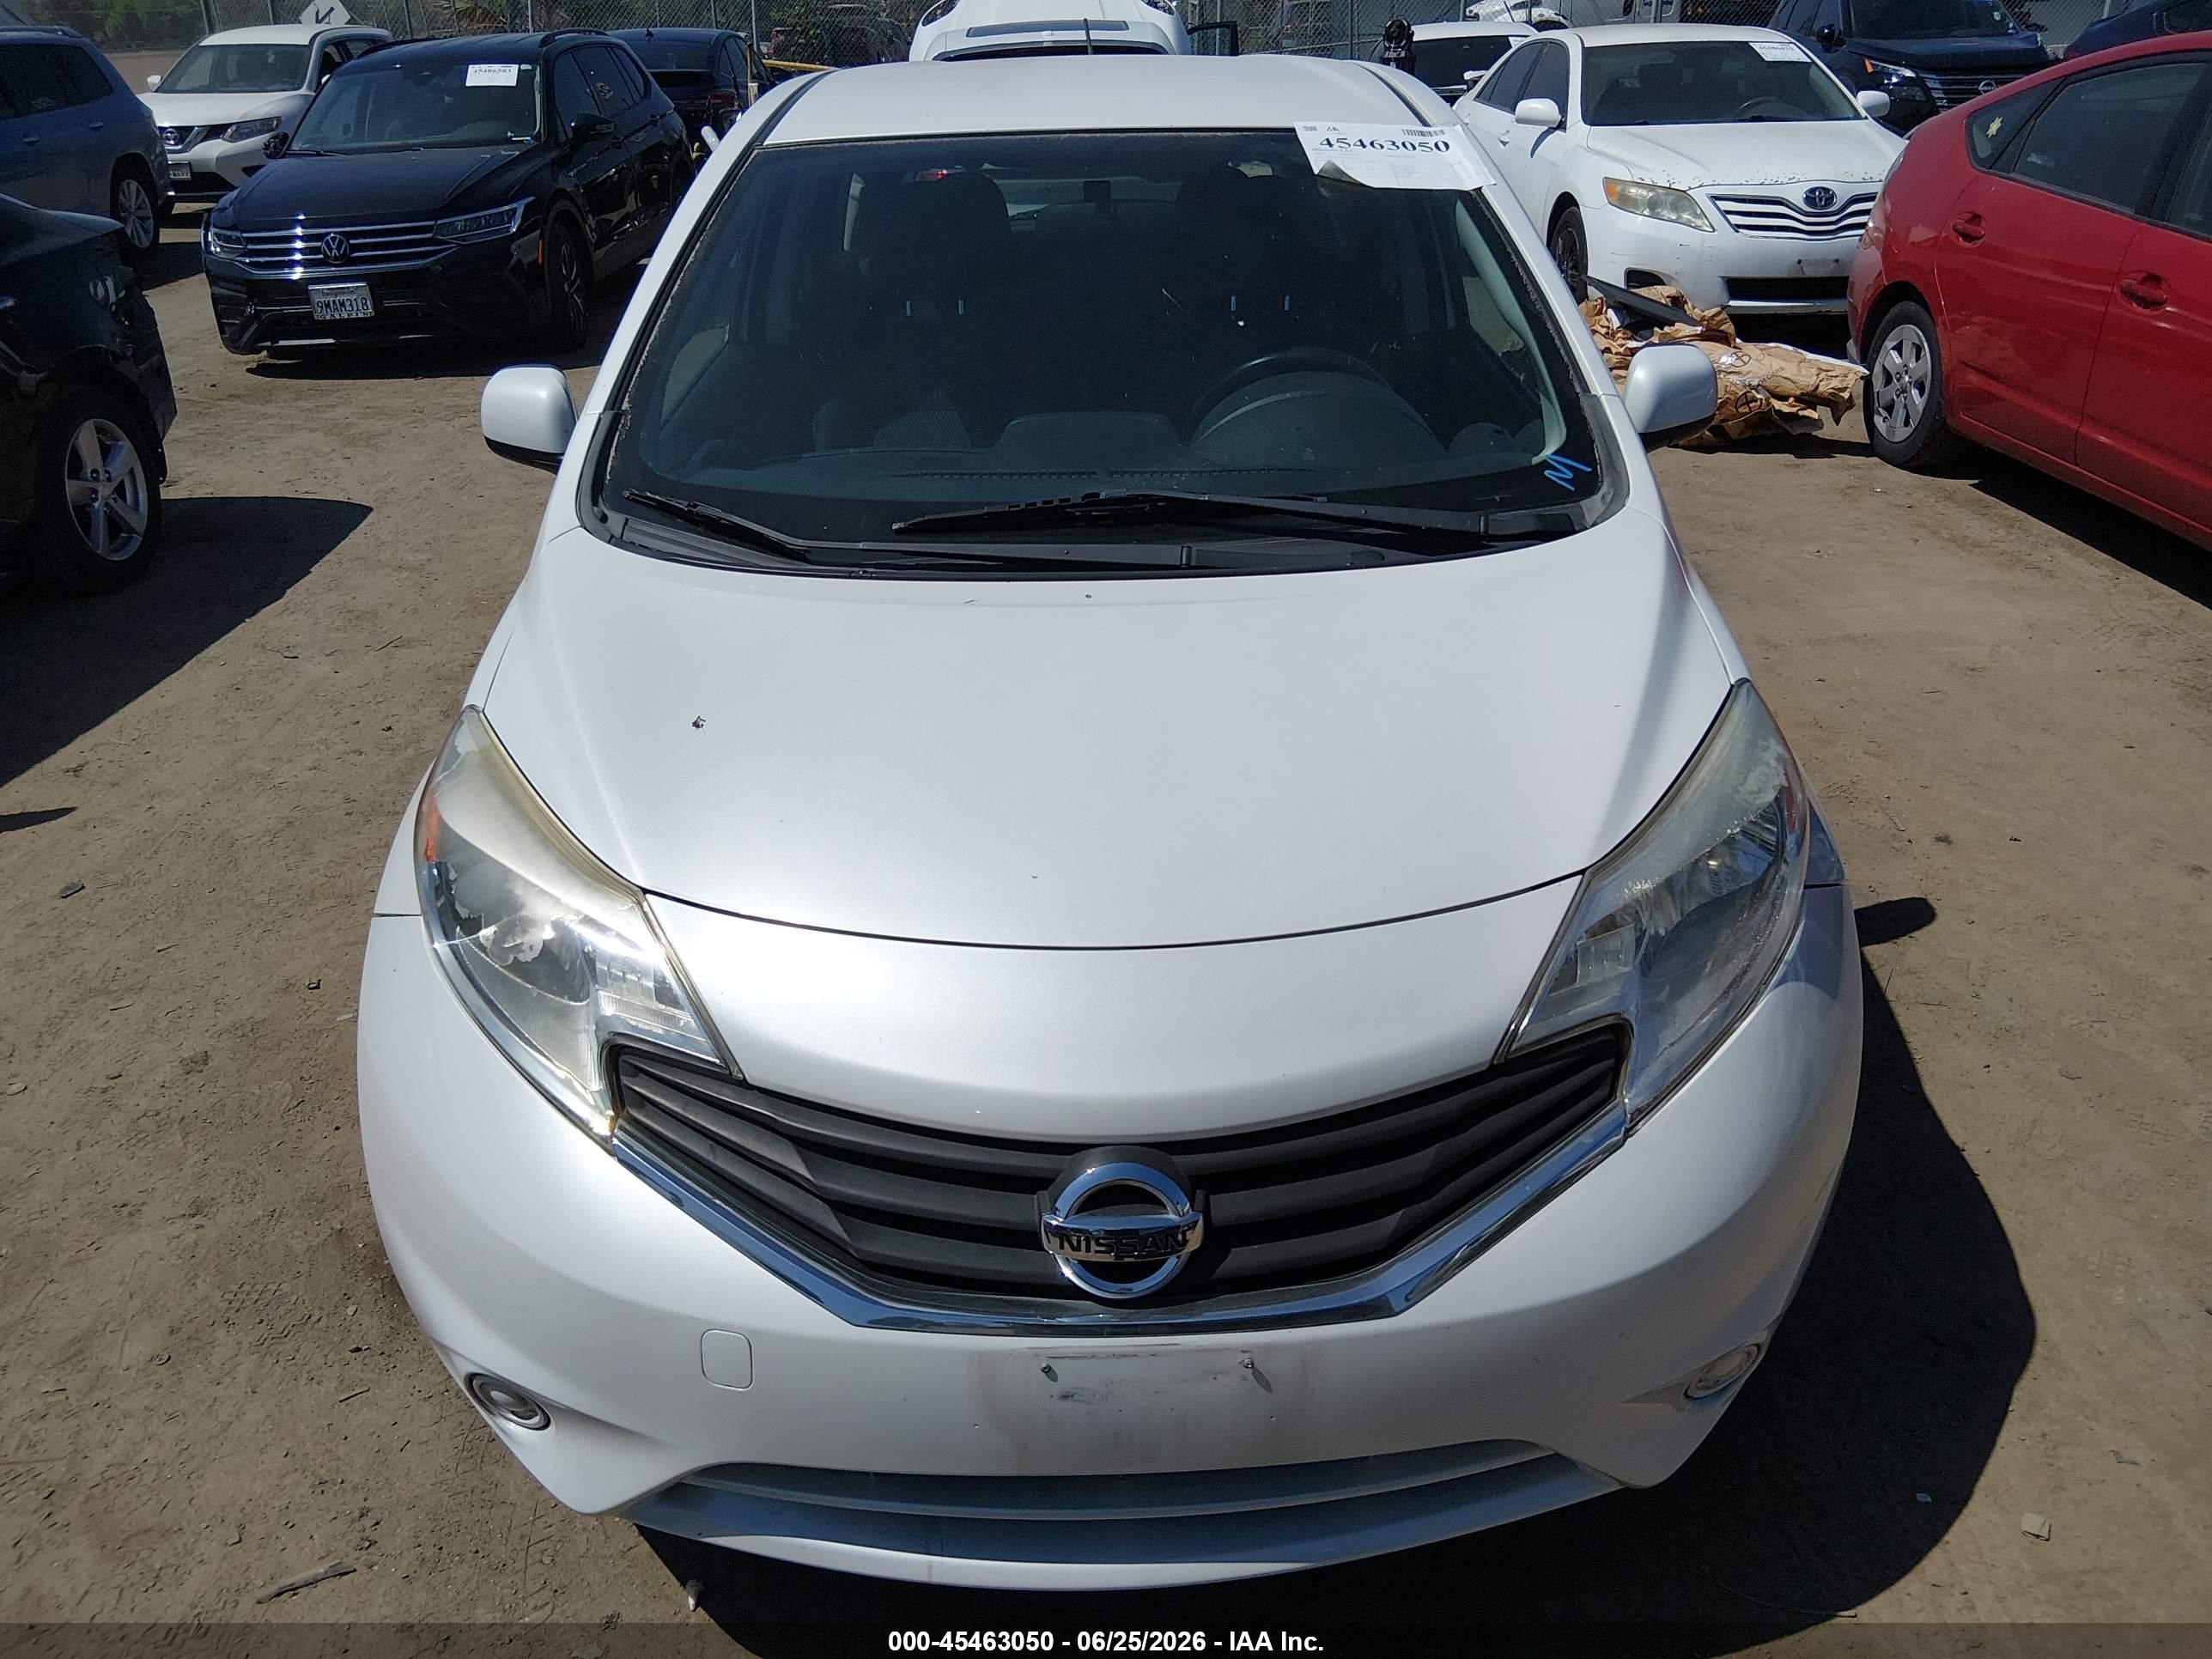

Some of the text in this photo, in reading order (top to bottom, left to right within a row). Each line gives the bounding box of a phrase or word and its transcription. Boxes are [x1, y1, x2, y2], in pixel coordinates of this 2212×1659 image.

[1319, 137, 1450, 153] 45463050
[315, 296, 369, 315] 9MAM318
[1059, 1230, 1188, 1255] NISSAN
